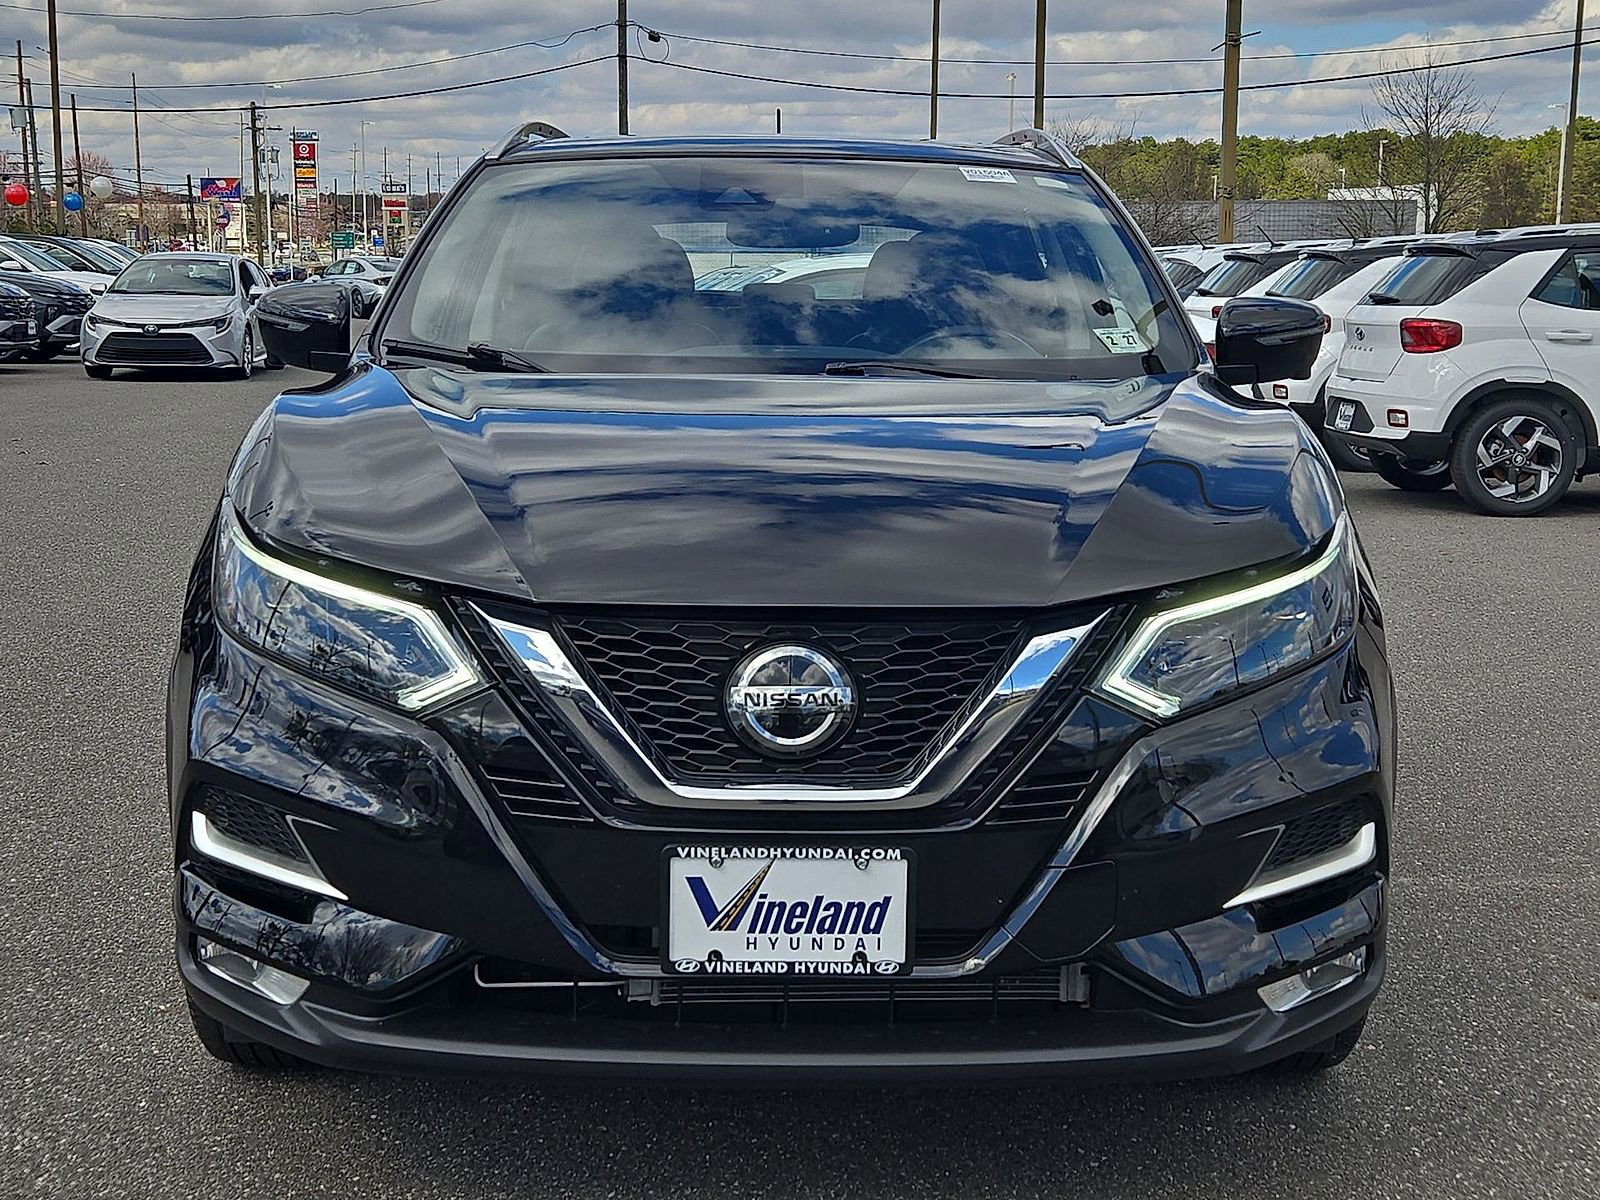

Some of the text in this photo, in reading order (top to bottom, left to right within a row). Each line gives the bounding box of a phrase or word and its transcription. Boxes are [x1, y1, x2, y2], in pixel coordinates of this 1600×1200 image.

[1106, 335, 1137, 345] 2 27
[744, 692, 838, 707] NISSAN
[677, 846, 902, 861] VINELANDHYUNDAI.COM
[685, 859, 893, 935] Vineland
[746, 937, 882, 951] HYUNDAI
[704, 961, 871, 975] VINELAND HYUNDAI
